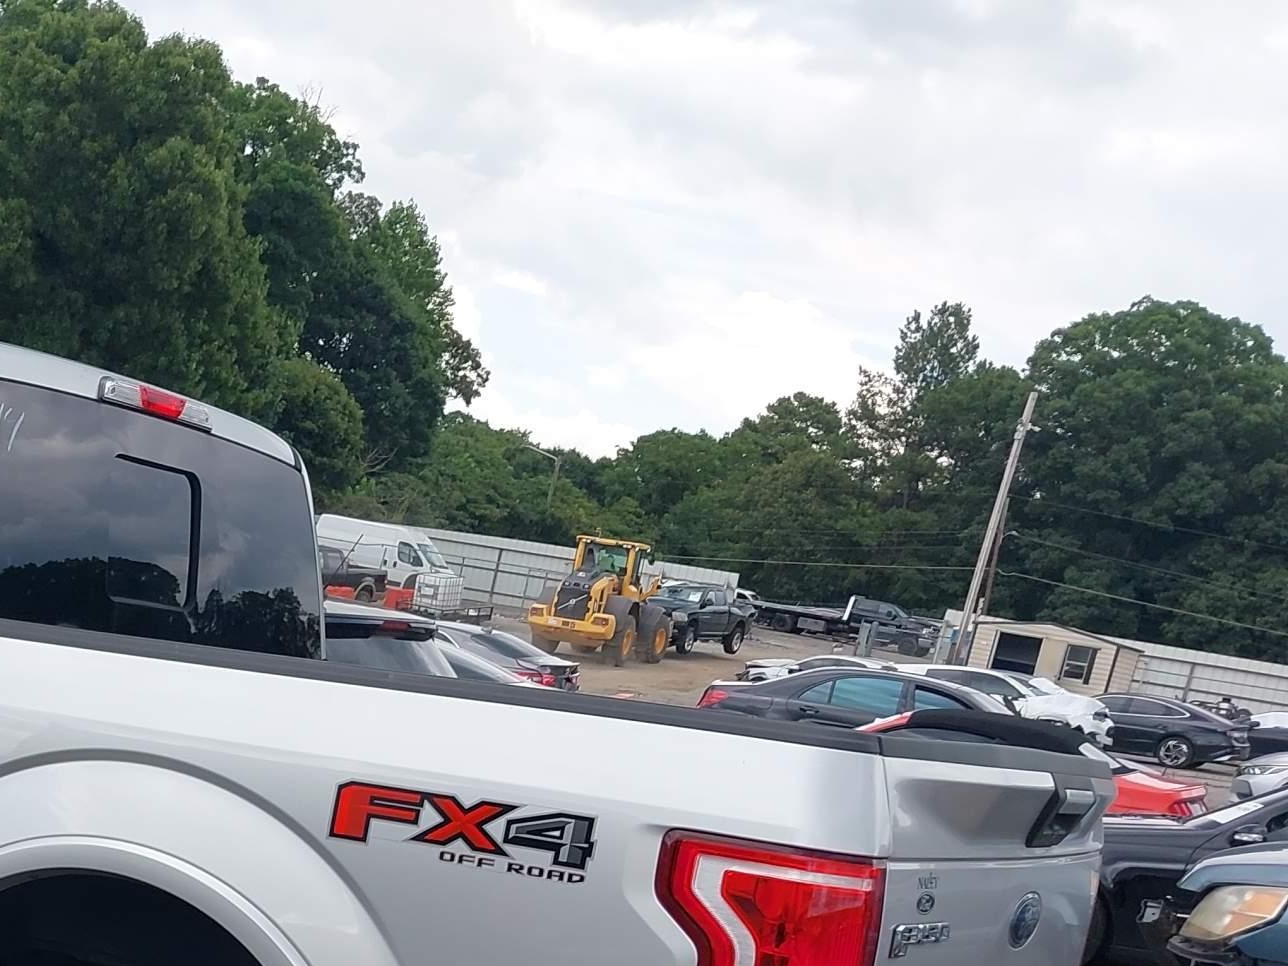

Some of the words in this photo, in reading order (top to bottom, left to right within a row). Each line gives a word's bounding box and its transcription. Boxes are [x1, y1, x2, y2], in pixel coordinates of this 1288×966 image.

[329, 780, 598, 870] FX4
[439, 850, 496, 868] OFF
[506, 862, 586, 884] ROAD
